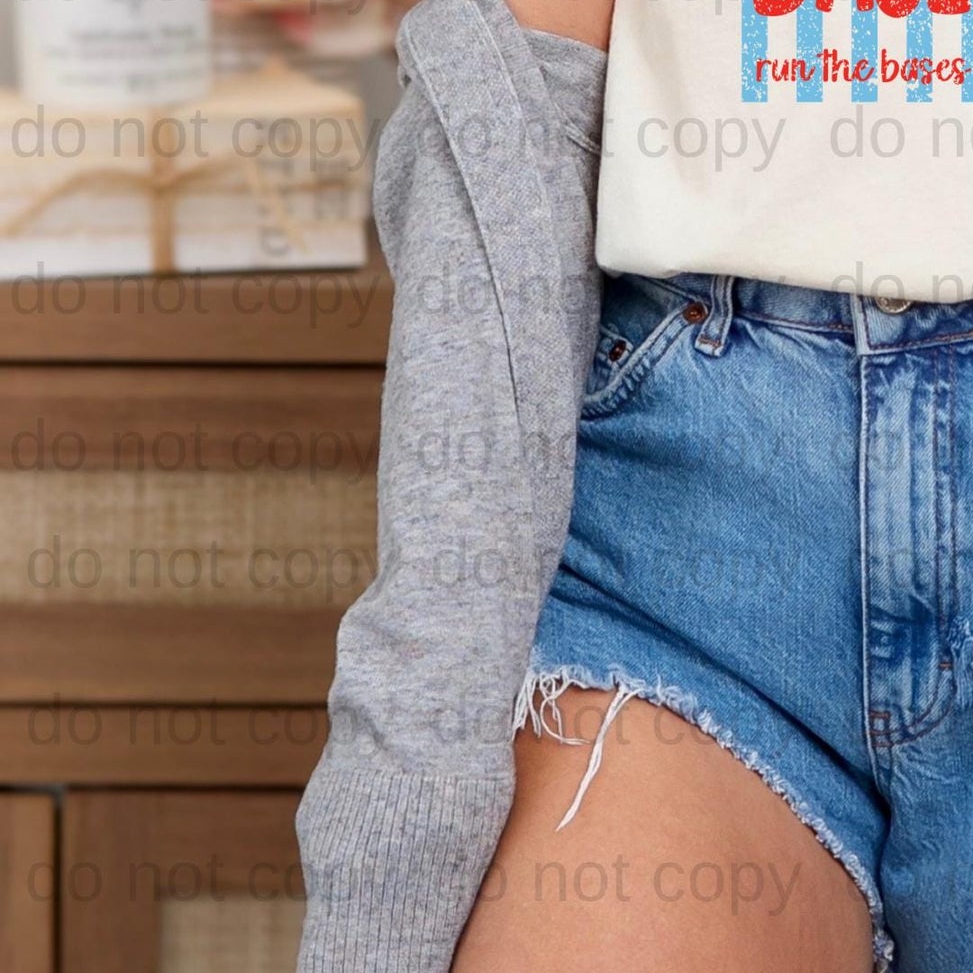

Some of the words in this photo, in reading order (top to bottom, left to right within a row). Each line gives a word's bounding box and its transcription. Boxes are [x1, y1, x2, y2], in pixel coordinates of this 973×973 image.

[756, 58, 815, 83] run
[816, 48, 875, 83] the
[881, 48, 971, 85] bases
